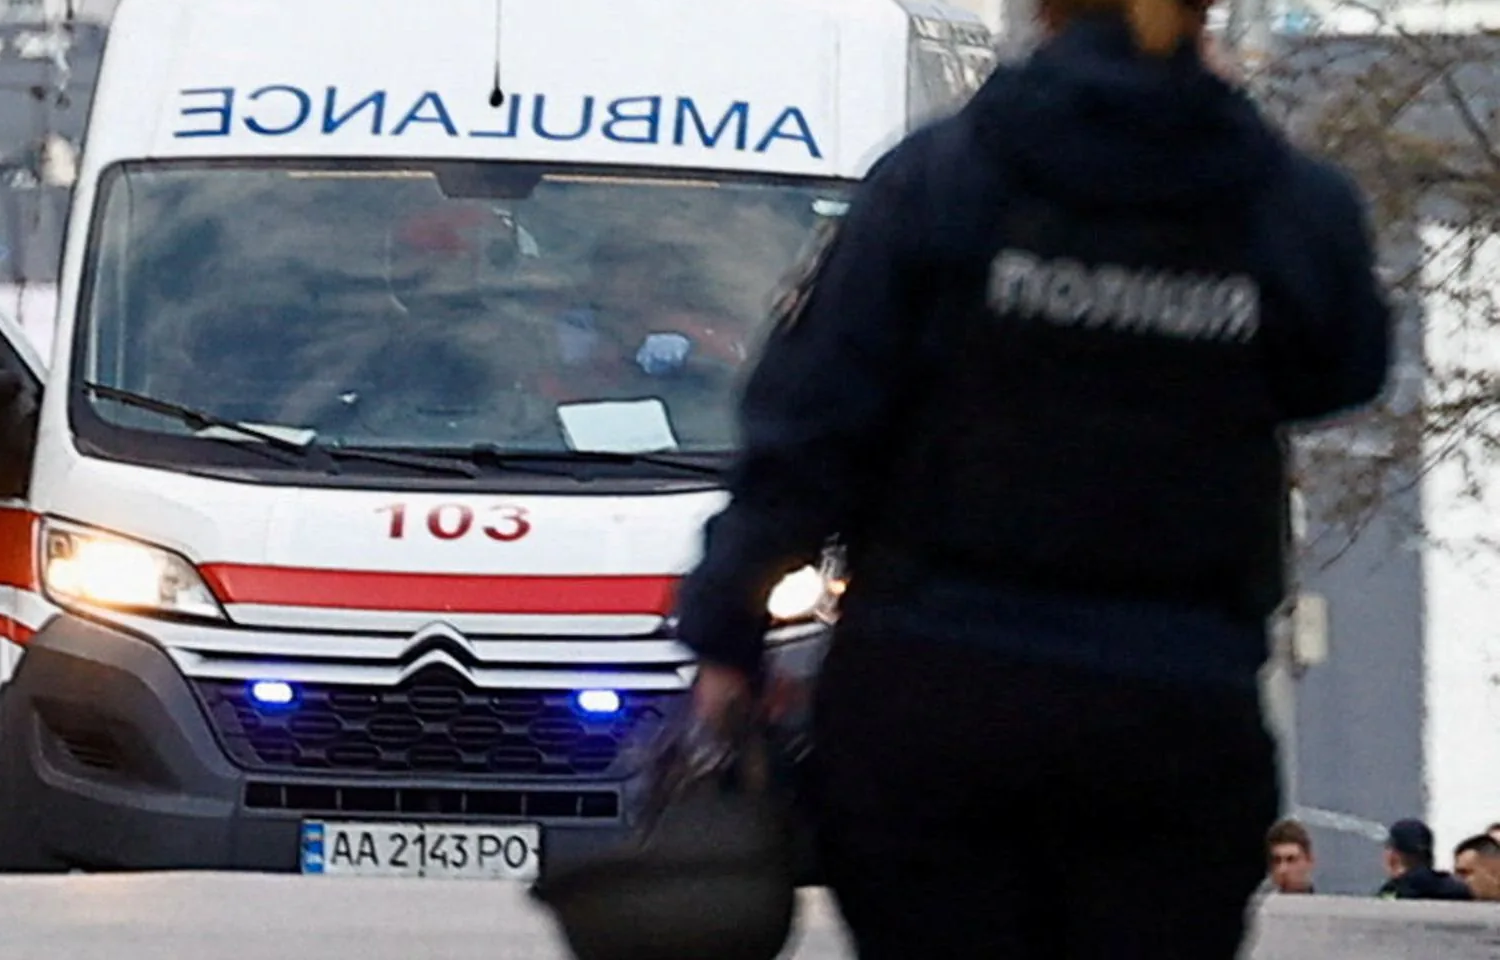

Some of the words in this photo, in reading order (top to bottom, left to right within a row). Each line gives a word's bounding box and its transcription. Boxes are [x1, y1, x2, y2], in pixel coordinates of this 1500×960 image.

[374, 502, 531, 542] 103
[331, 831, 378, 867] AA
[389, 832, 468, 869] 2143
[477, 834, 528, 869] PO
